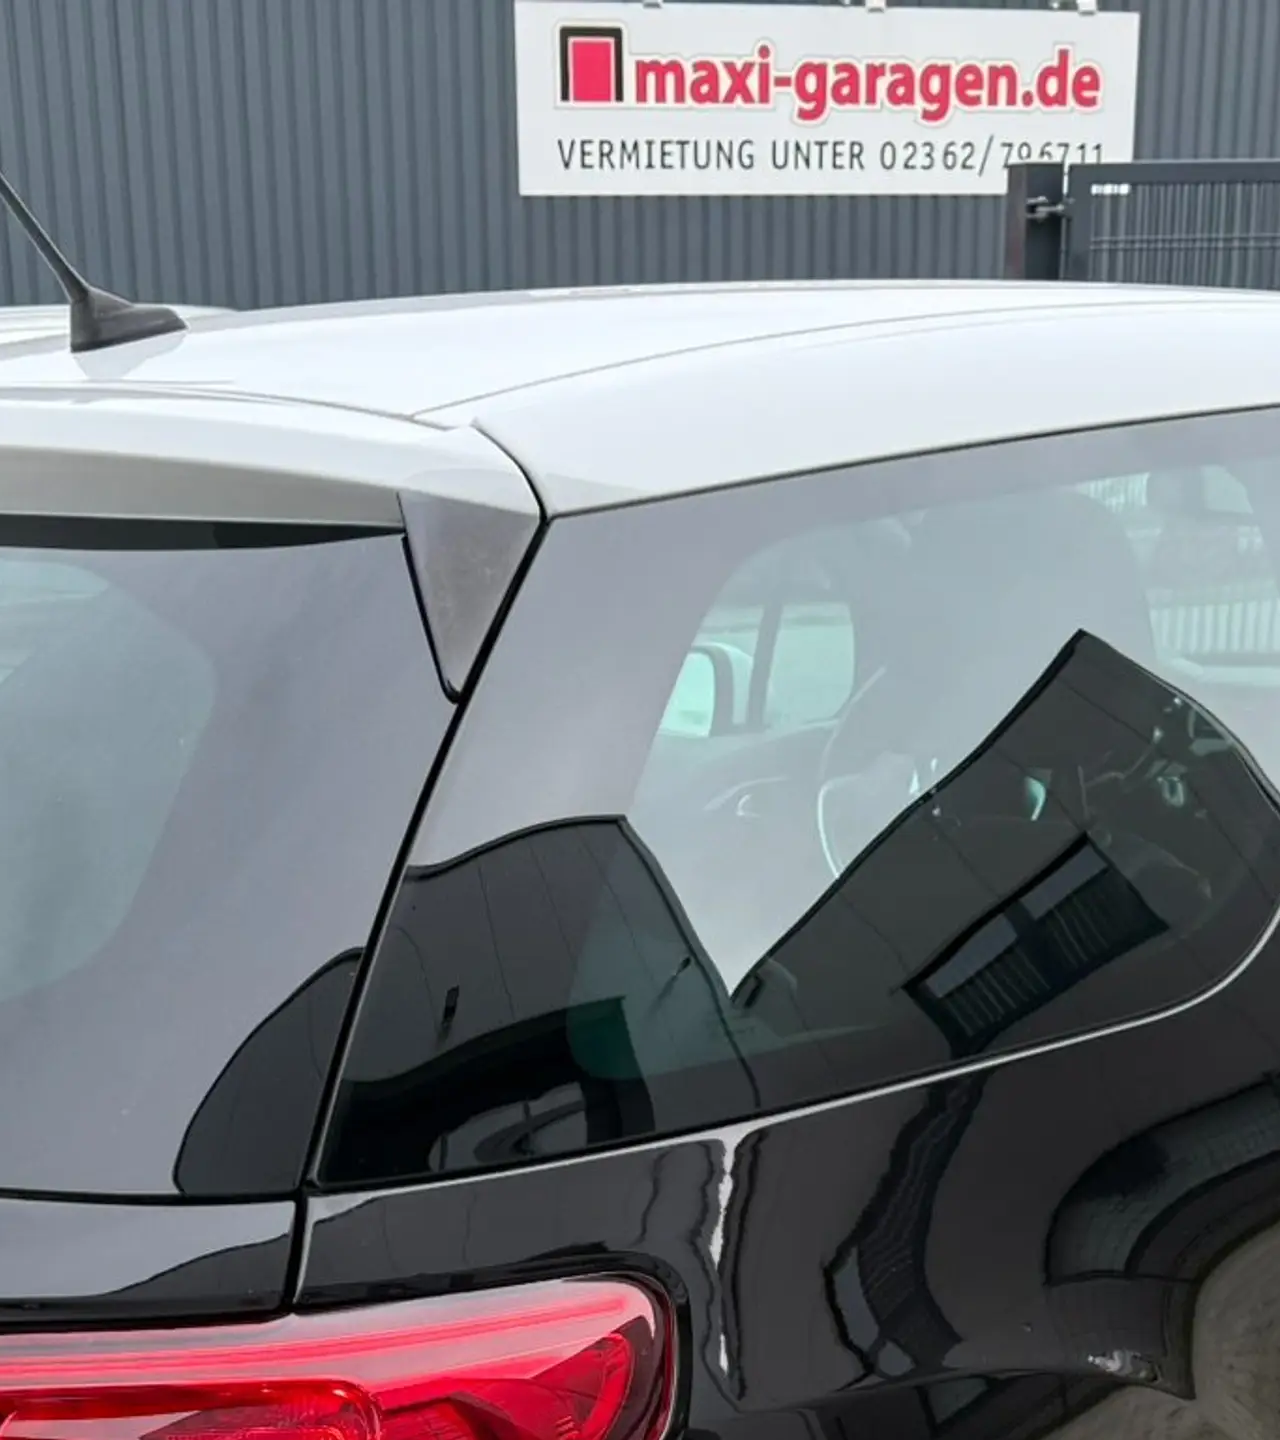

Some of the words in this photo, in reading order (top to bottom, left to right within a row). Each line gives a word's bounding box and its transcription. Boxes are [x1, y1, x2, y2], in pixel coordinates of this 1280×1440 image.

[634, 45, 1102, 123] maxi-garagen.de
[557, 138, 755, 172] VERMIETUNG
[771, 140, 866, 171] UNTER
